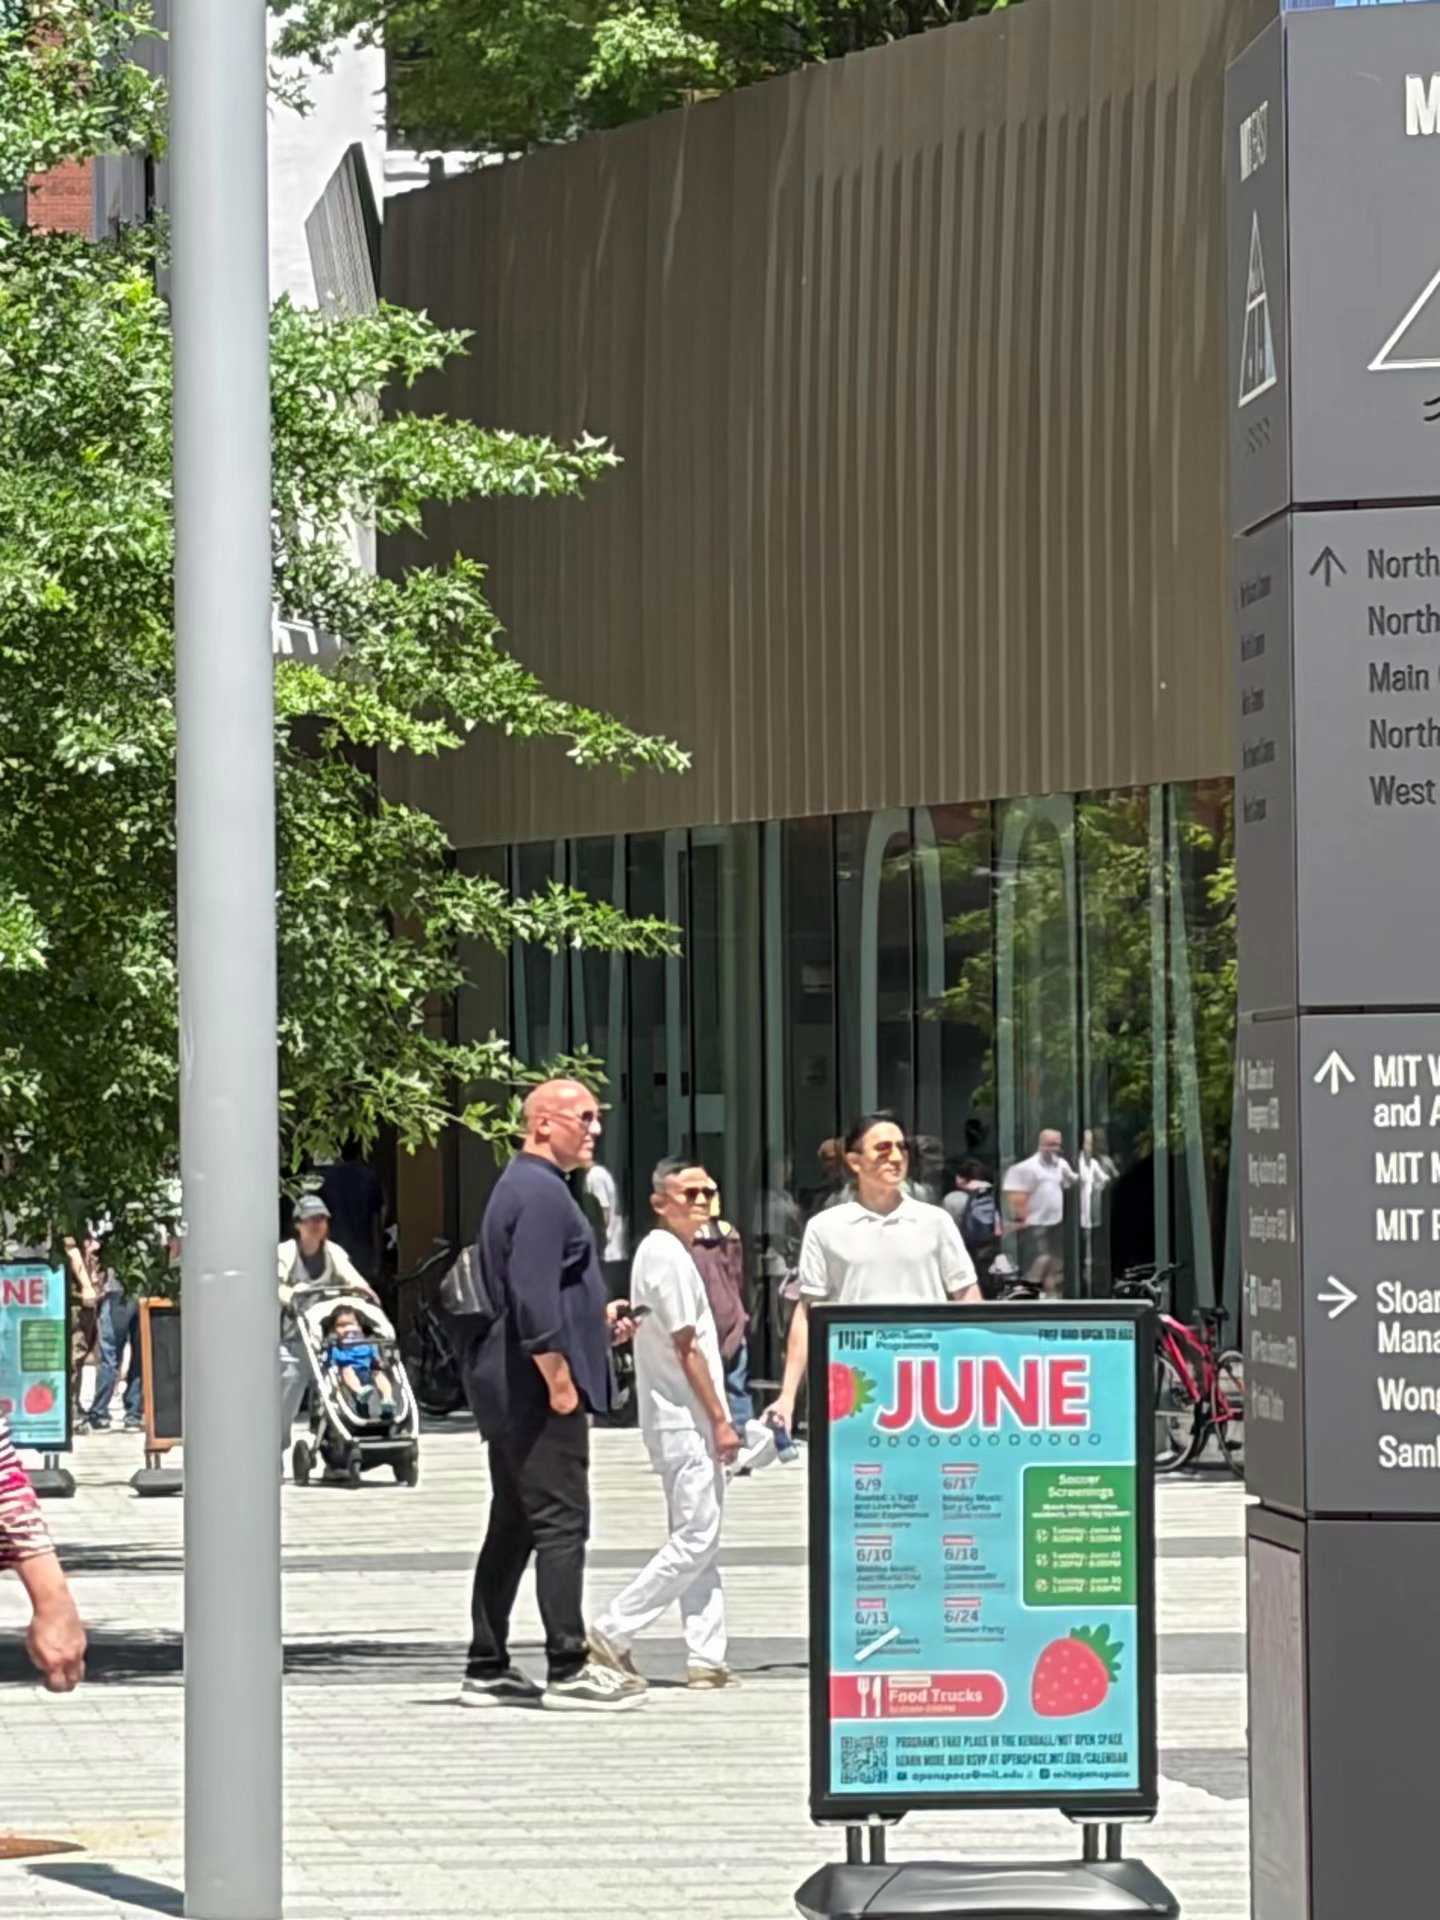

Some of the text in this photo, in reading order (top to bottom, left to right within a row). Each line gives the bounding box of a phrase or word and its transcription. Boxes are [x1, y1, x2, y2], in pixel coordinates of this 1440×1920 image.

[1367, 546, 1440, 579] North
[1368, 603, 1440, 636] North
[1368, 662, 1430, 693] Main
[1369, 717, 1440, 750] North
[1368, 776, 1436, 806] West
[1373, 1054, 1423, 1088] MIT
[1373, 1095, 1421, 1127] and
[1375, 1151, 1424, 1184] MIT
[1376, 1208, 1425, 1241] MIT
[875, 1357, 1089, 1431] JUNE
[854, 1477, 882, 1491] 6/9
[856, 1548, 893, 1562] 6/10
[944, 1547, 979, 1561] 6/18
[855, 1611, 889, 1625] 6/13
[944, 1609, 979, 1623] 6/24
[888, 1688, 983, 1703] Food Trucks
